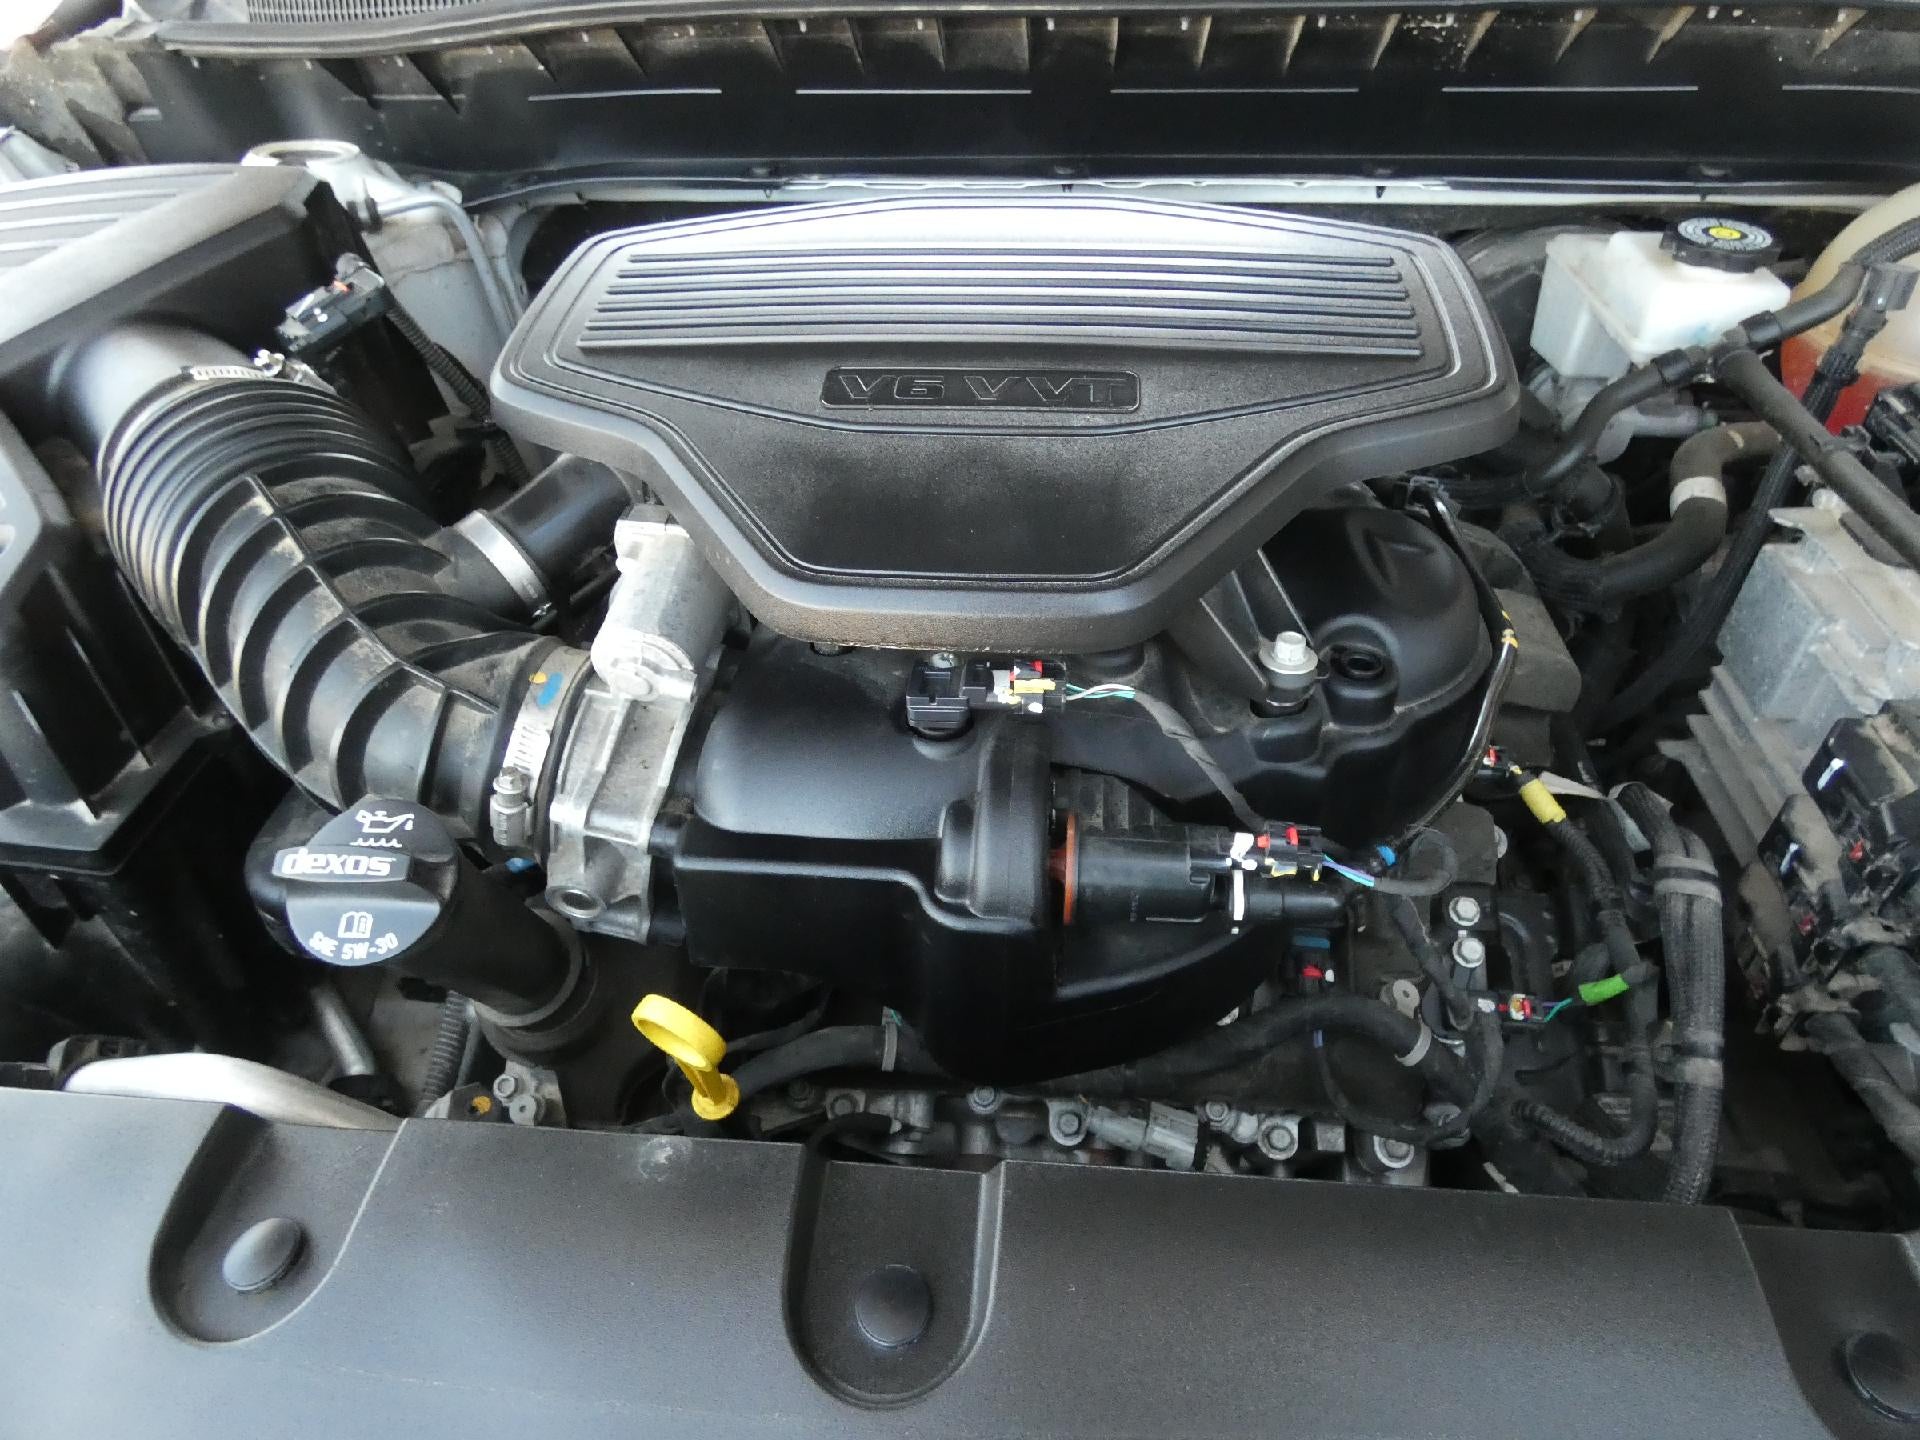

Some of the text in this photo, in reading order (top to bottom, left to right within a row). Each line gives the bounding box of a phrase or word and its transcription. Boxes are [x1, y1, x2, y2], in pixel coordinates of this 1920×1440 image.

[838, 375, 1131, 403] V6 VVT
[282, 847, 394, 876] dexos
[341, 932, 399, 960] 5W-30
